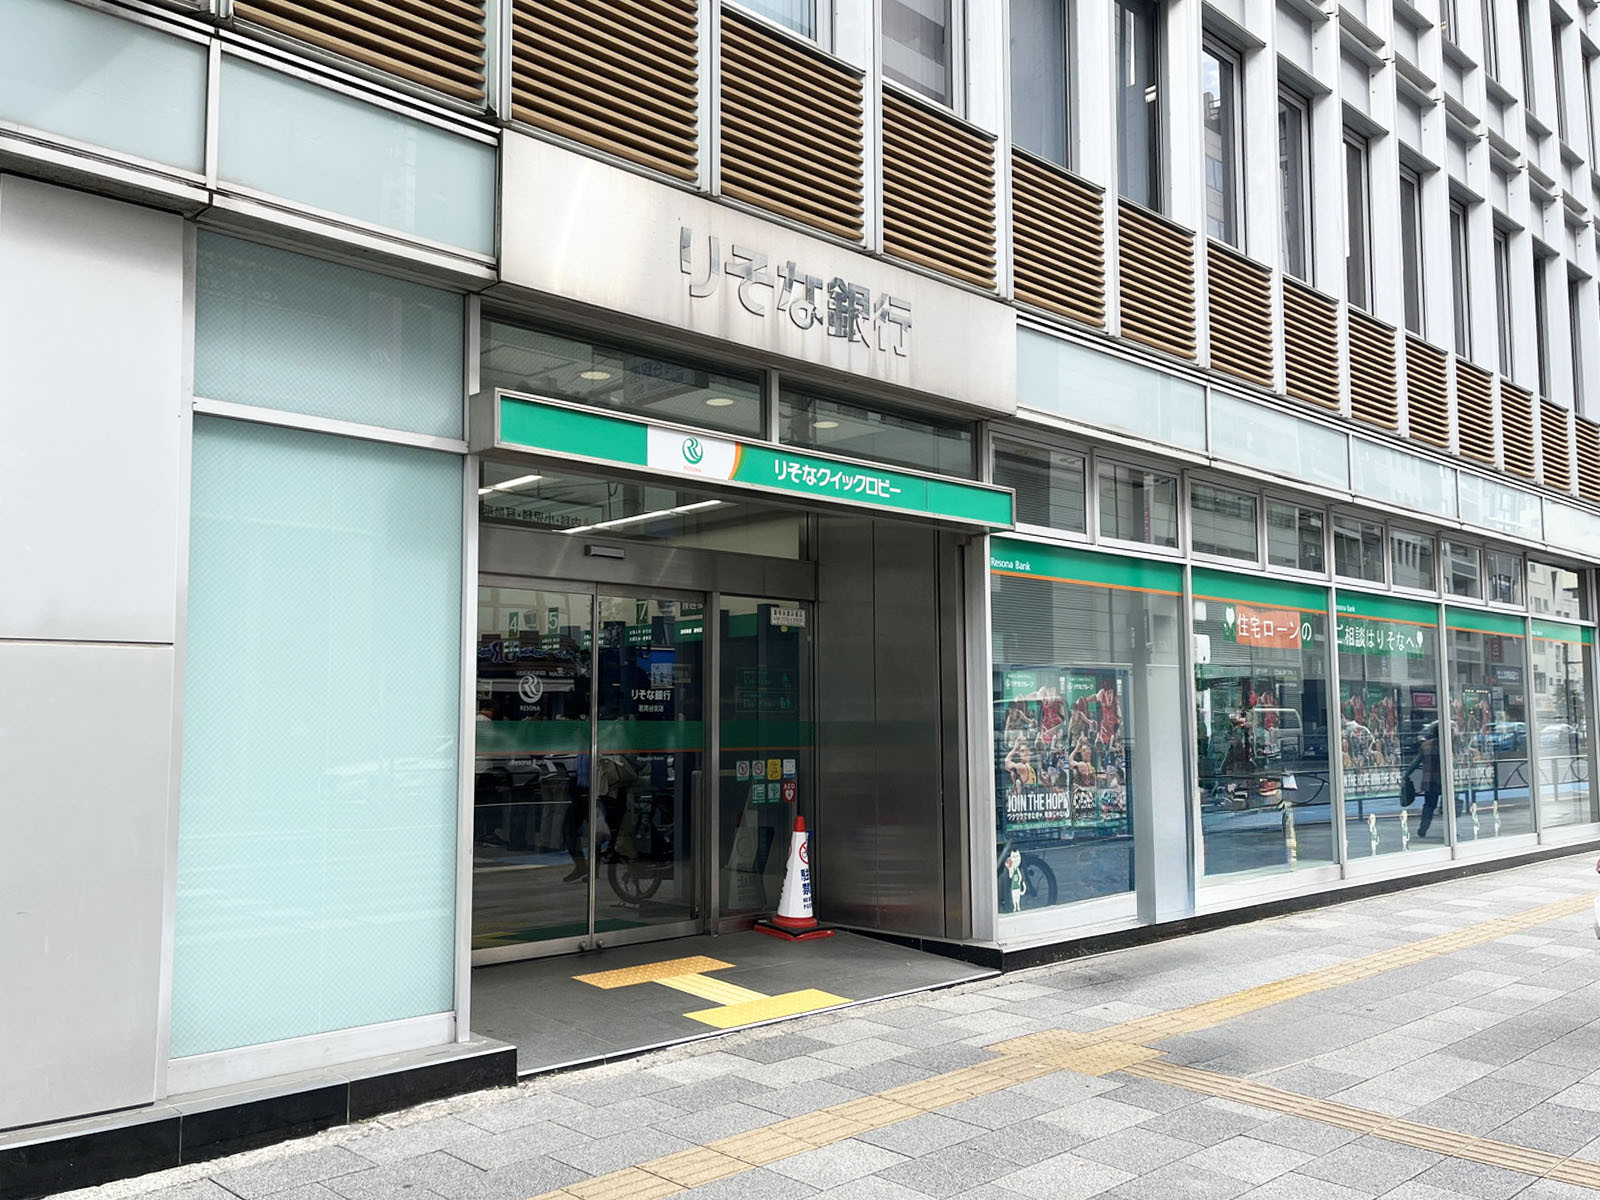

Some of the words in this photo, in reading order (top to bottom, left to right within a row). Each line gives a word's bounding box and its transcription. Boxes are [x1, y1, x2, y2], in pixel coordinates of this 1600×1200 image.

[679, 226, 912, 358] りそな銀行
[774, 459, 901, 498] りそなクイックロビー
[991, 556, 1014, 569] Resona
[1015, 560, 1031, 571] Bank
[509, 616, 517, 632] 4
[549, 612, 558, 629] 5
[1237, 613, 1312, 641] 住宅ローンの
[631, 689, 671, 701] りそな銀行
[1007, 794, 1026, 812] JOIN
[1028, 793, 1045, 811] THE
